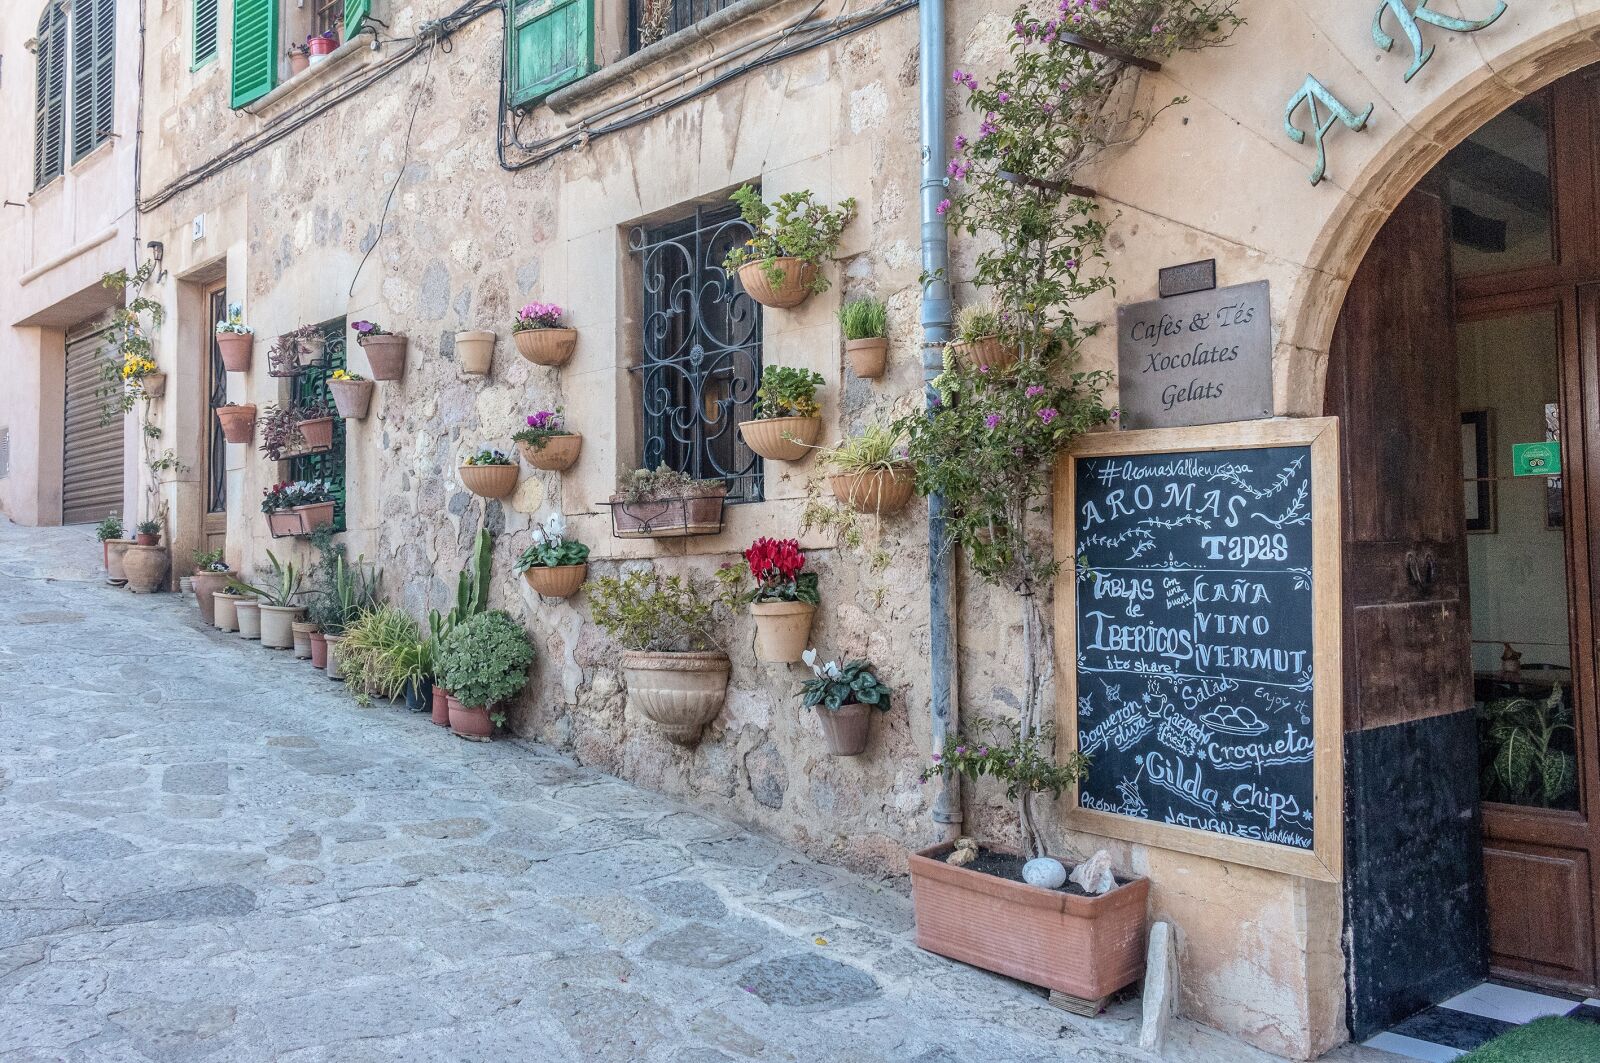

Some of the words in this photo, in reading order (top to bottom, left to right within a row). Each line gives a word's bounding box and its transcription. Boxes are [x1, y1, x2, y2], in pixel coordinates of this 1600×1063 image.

[1189, 312, 1210, 332] &
[1217, 303, 1255, 327] Tés
[1142, 343, 1240, 373] Xocolates
[1161, 378, 1224, 411] Gelats
[1082, 483, 1247, 530] AROMAS
[1201, 533, 1288, 567] Tapas
[1166, 585, 1186, 597] una
[1196, 579, 1271, 604] CAÑA
[1125, 598, 1144, 617] de
[1194, 612, 1269, 635] VINO
[1134, 658, 1180, 674] share!
[1195, 643, 1306, 674] VERMUT
[1182, 673, 1239, 710] Salads
[1254, 687, 1291, 714] Enjoy
[1295, 700, 1308, 714] it
[1114, 717, 1153, 746] oliva
[1146, 751, 1219, 807] Gilda
[1232, 783, 1300, 829] Chips
[1164, 806, 1262, 840] NATURALES
